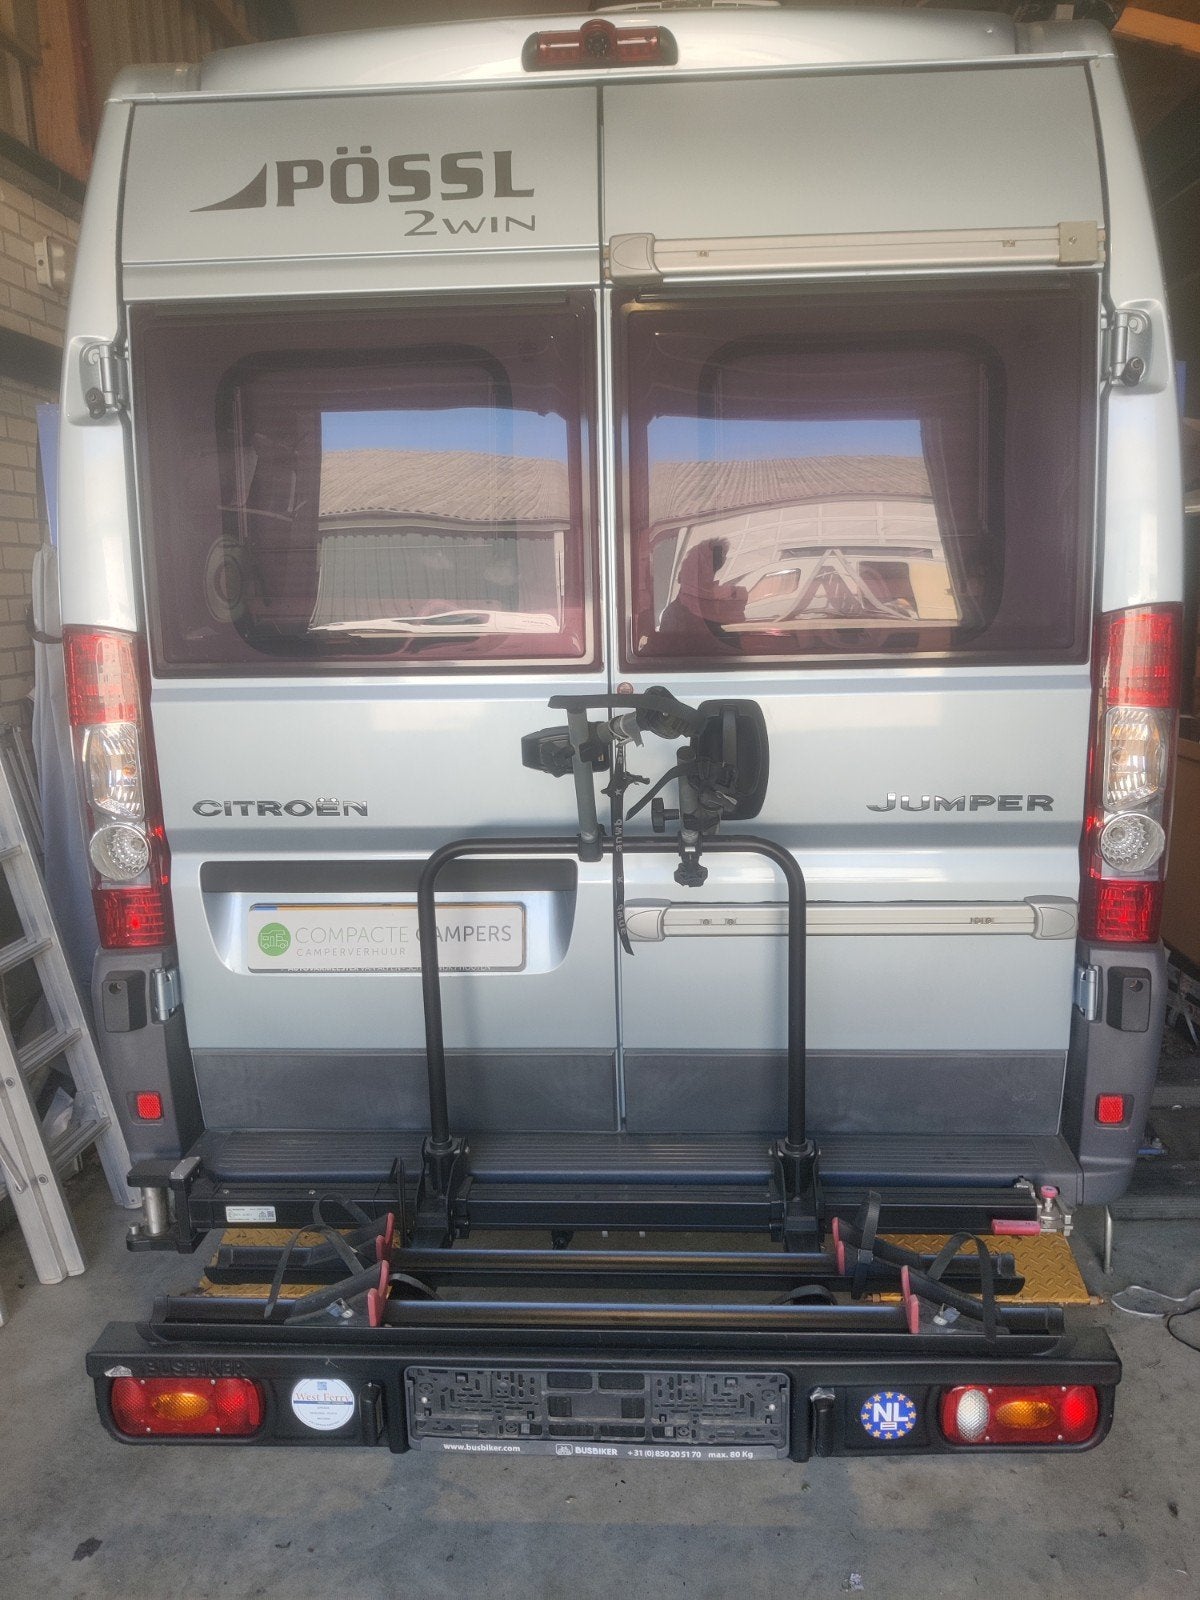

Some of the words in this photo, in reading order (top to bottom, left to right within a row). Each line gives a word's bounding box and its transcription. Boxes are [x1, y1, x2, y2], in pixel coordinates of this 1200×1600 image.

[275, 145, 535, 206] PÖSSL
[403, 210, 536, 236] 2WIN
[192, 797, 368, 817] CITROËN
[866, 792, 1055, 812] JUMPER
[295, 926, 409, 944] COMPACTE
[296, 947, 406, 957] CAMPERVERHUUR
[296, 1393, 320, 1401] West
[323, 1393, 350, 1402] Ferry
[873, 1402, 909, 1422] NL
[443, 1443, 521, 1452] www.busbiker.com
[575, 1446, 618, 1456] BUSBIKER
[708, 1451, 729, 1459] max.
[730, 1451, 741, 1459] 80
[742, 1451, 754, 1460] Kg
